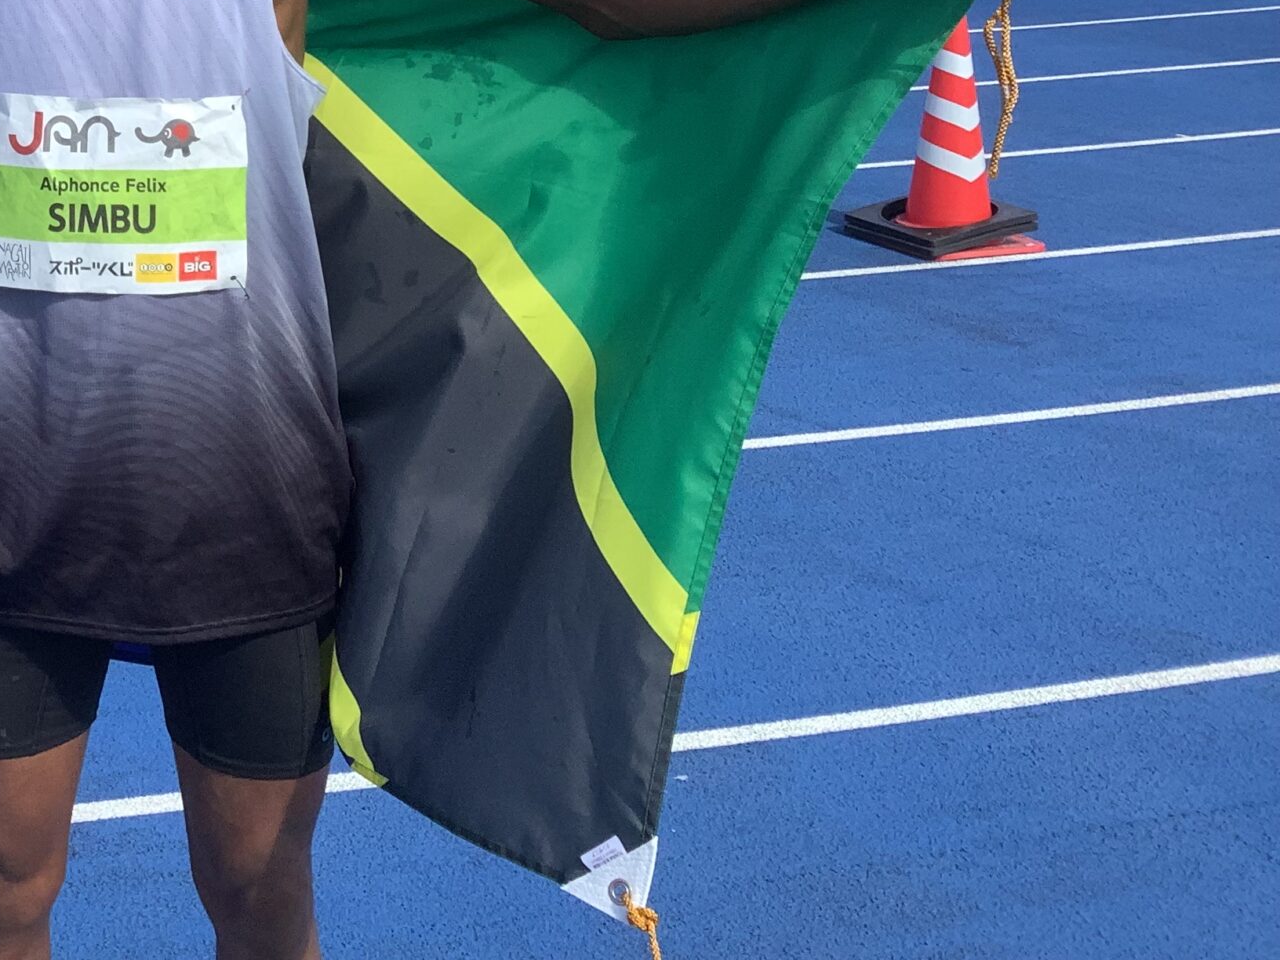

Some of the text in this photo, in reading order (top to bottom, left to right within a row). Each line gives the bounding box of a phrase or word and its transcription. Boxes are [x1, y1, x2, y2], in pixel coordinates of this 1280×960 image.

[40, 177, 167, 196] Alphonce Felix
[48, 203, 157, 234] SIMBU
[49, 257, 133, 278] スポーツくじ
